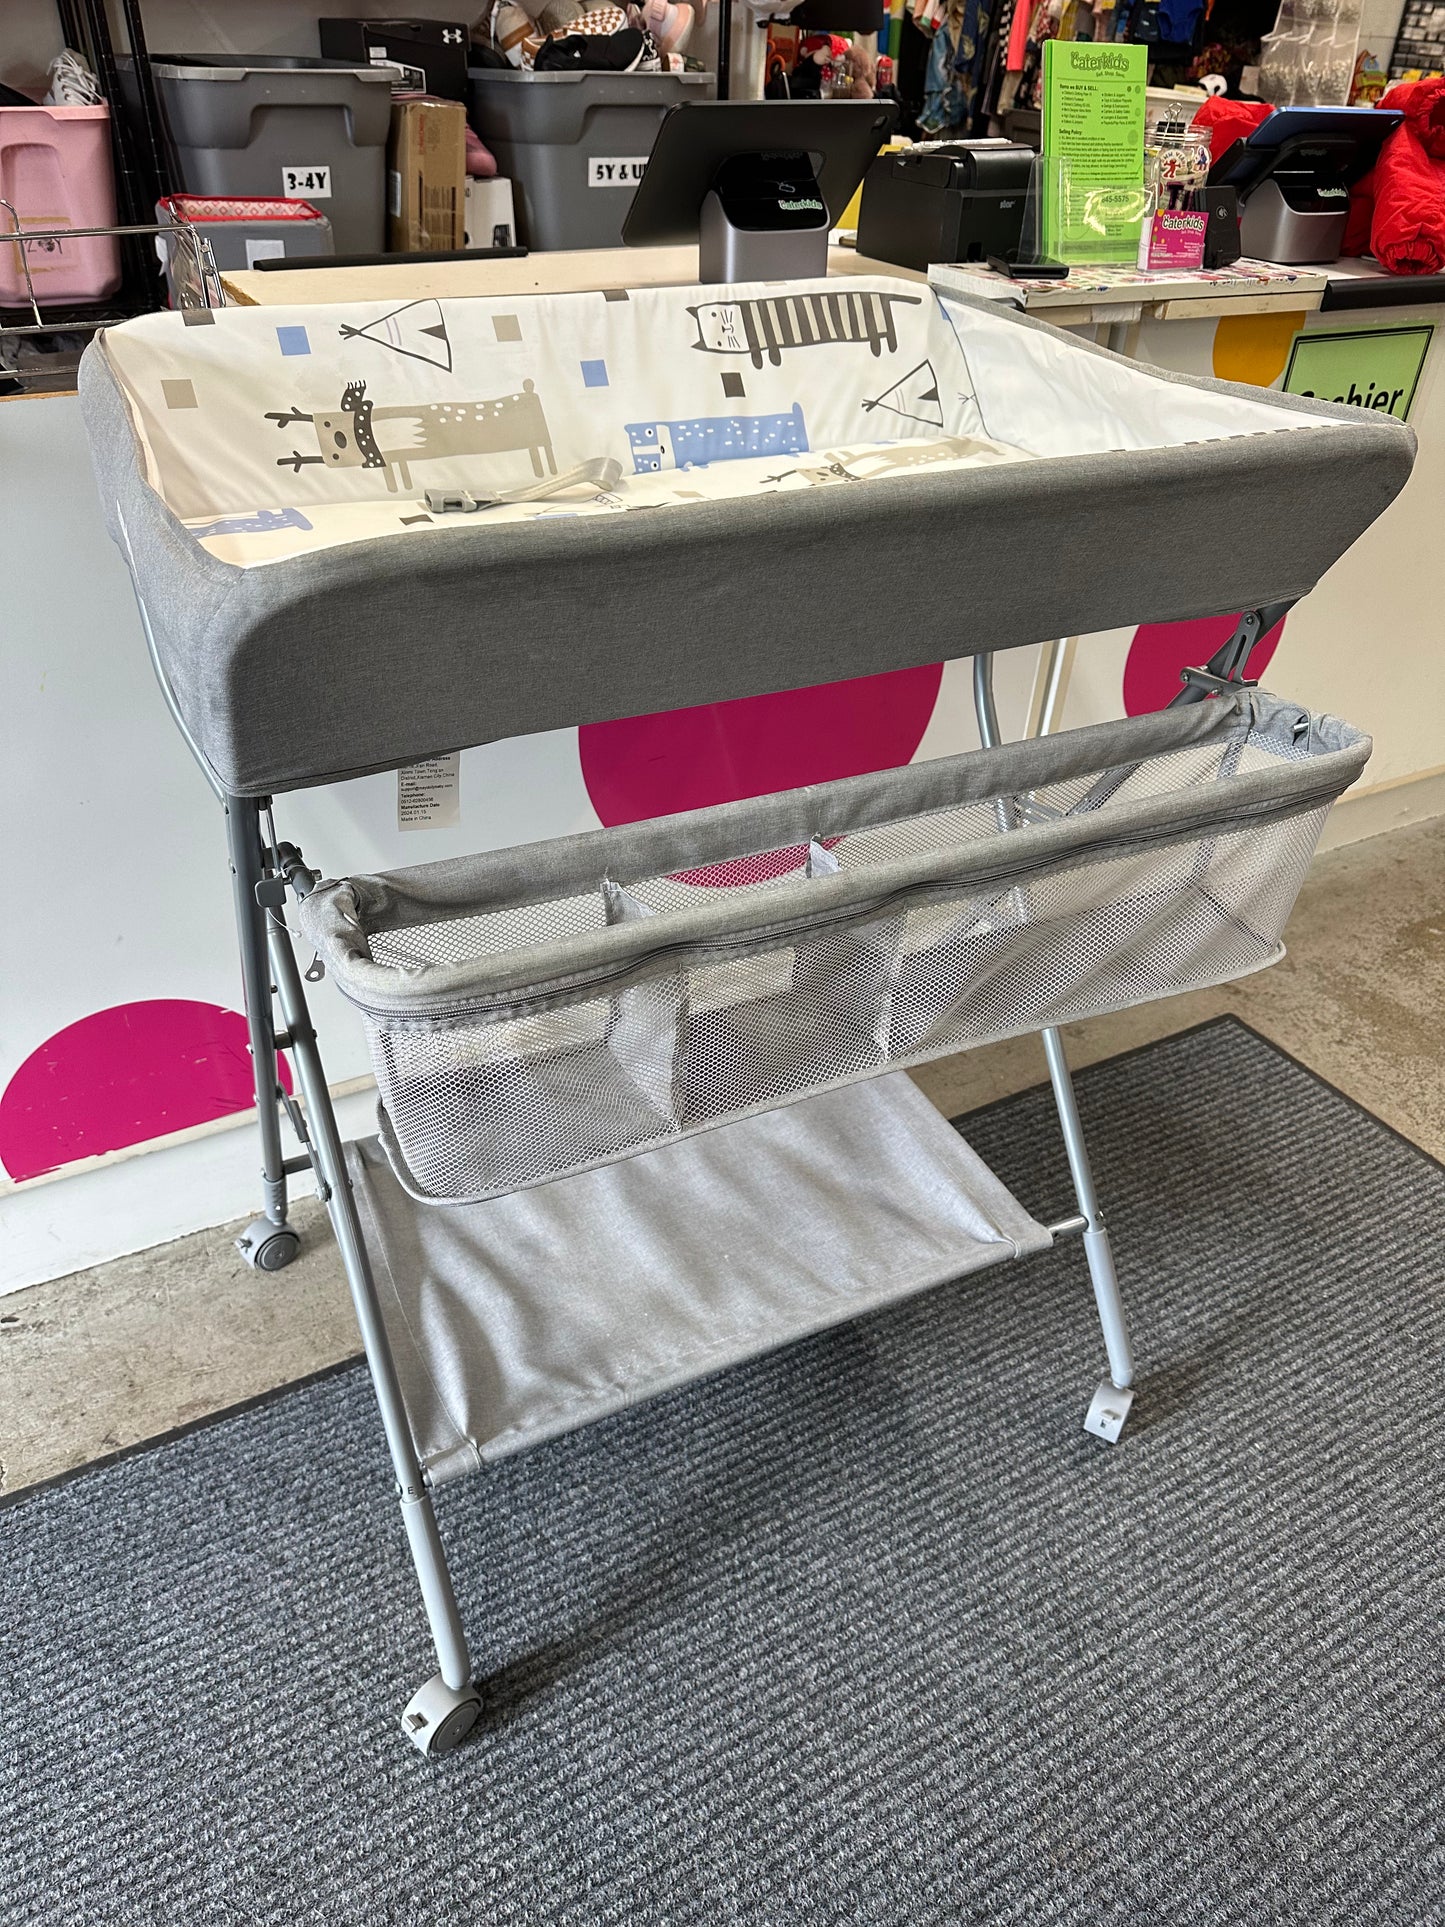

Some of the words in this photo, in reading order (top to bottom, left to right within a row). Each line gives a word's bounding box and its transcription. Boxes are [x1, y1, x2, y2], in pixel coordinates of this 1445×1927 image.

[597, 164, 615, 180] 5Y
[619, 164, 628, 180] &
[287, 172, 326, 190] 3-4Y
[1162, 214, 1205, 231] Caterkids
[407, 1486, 414, 1495] E
